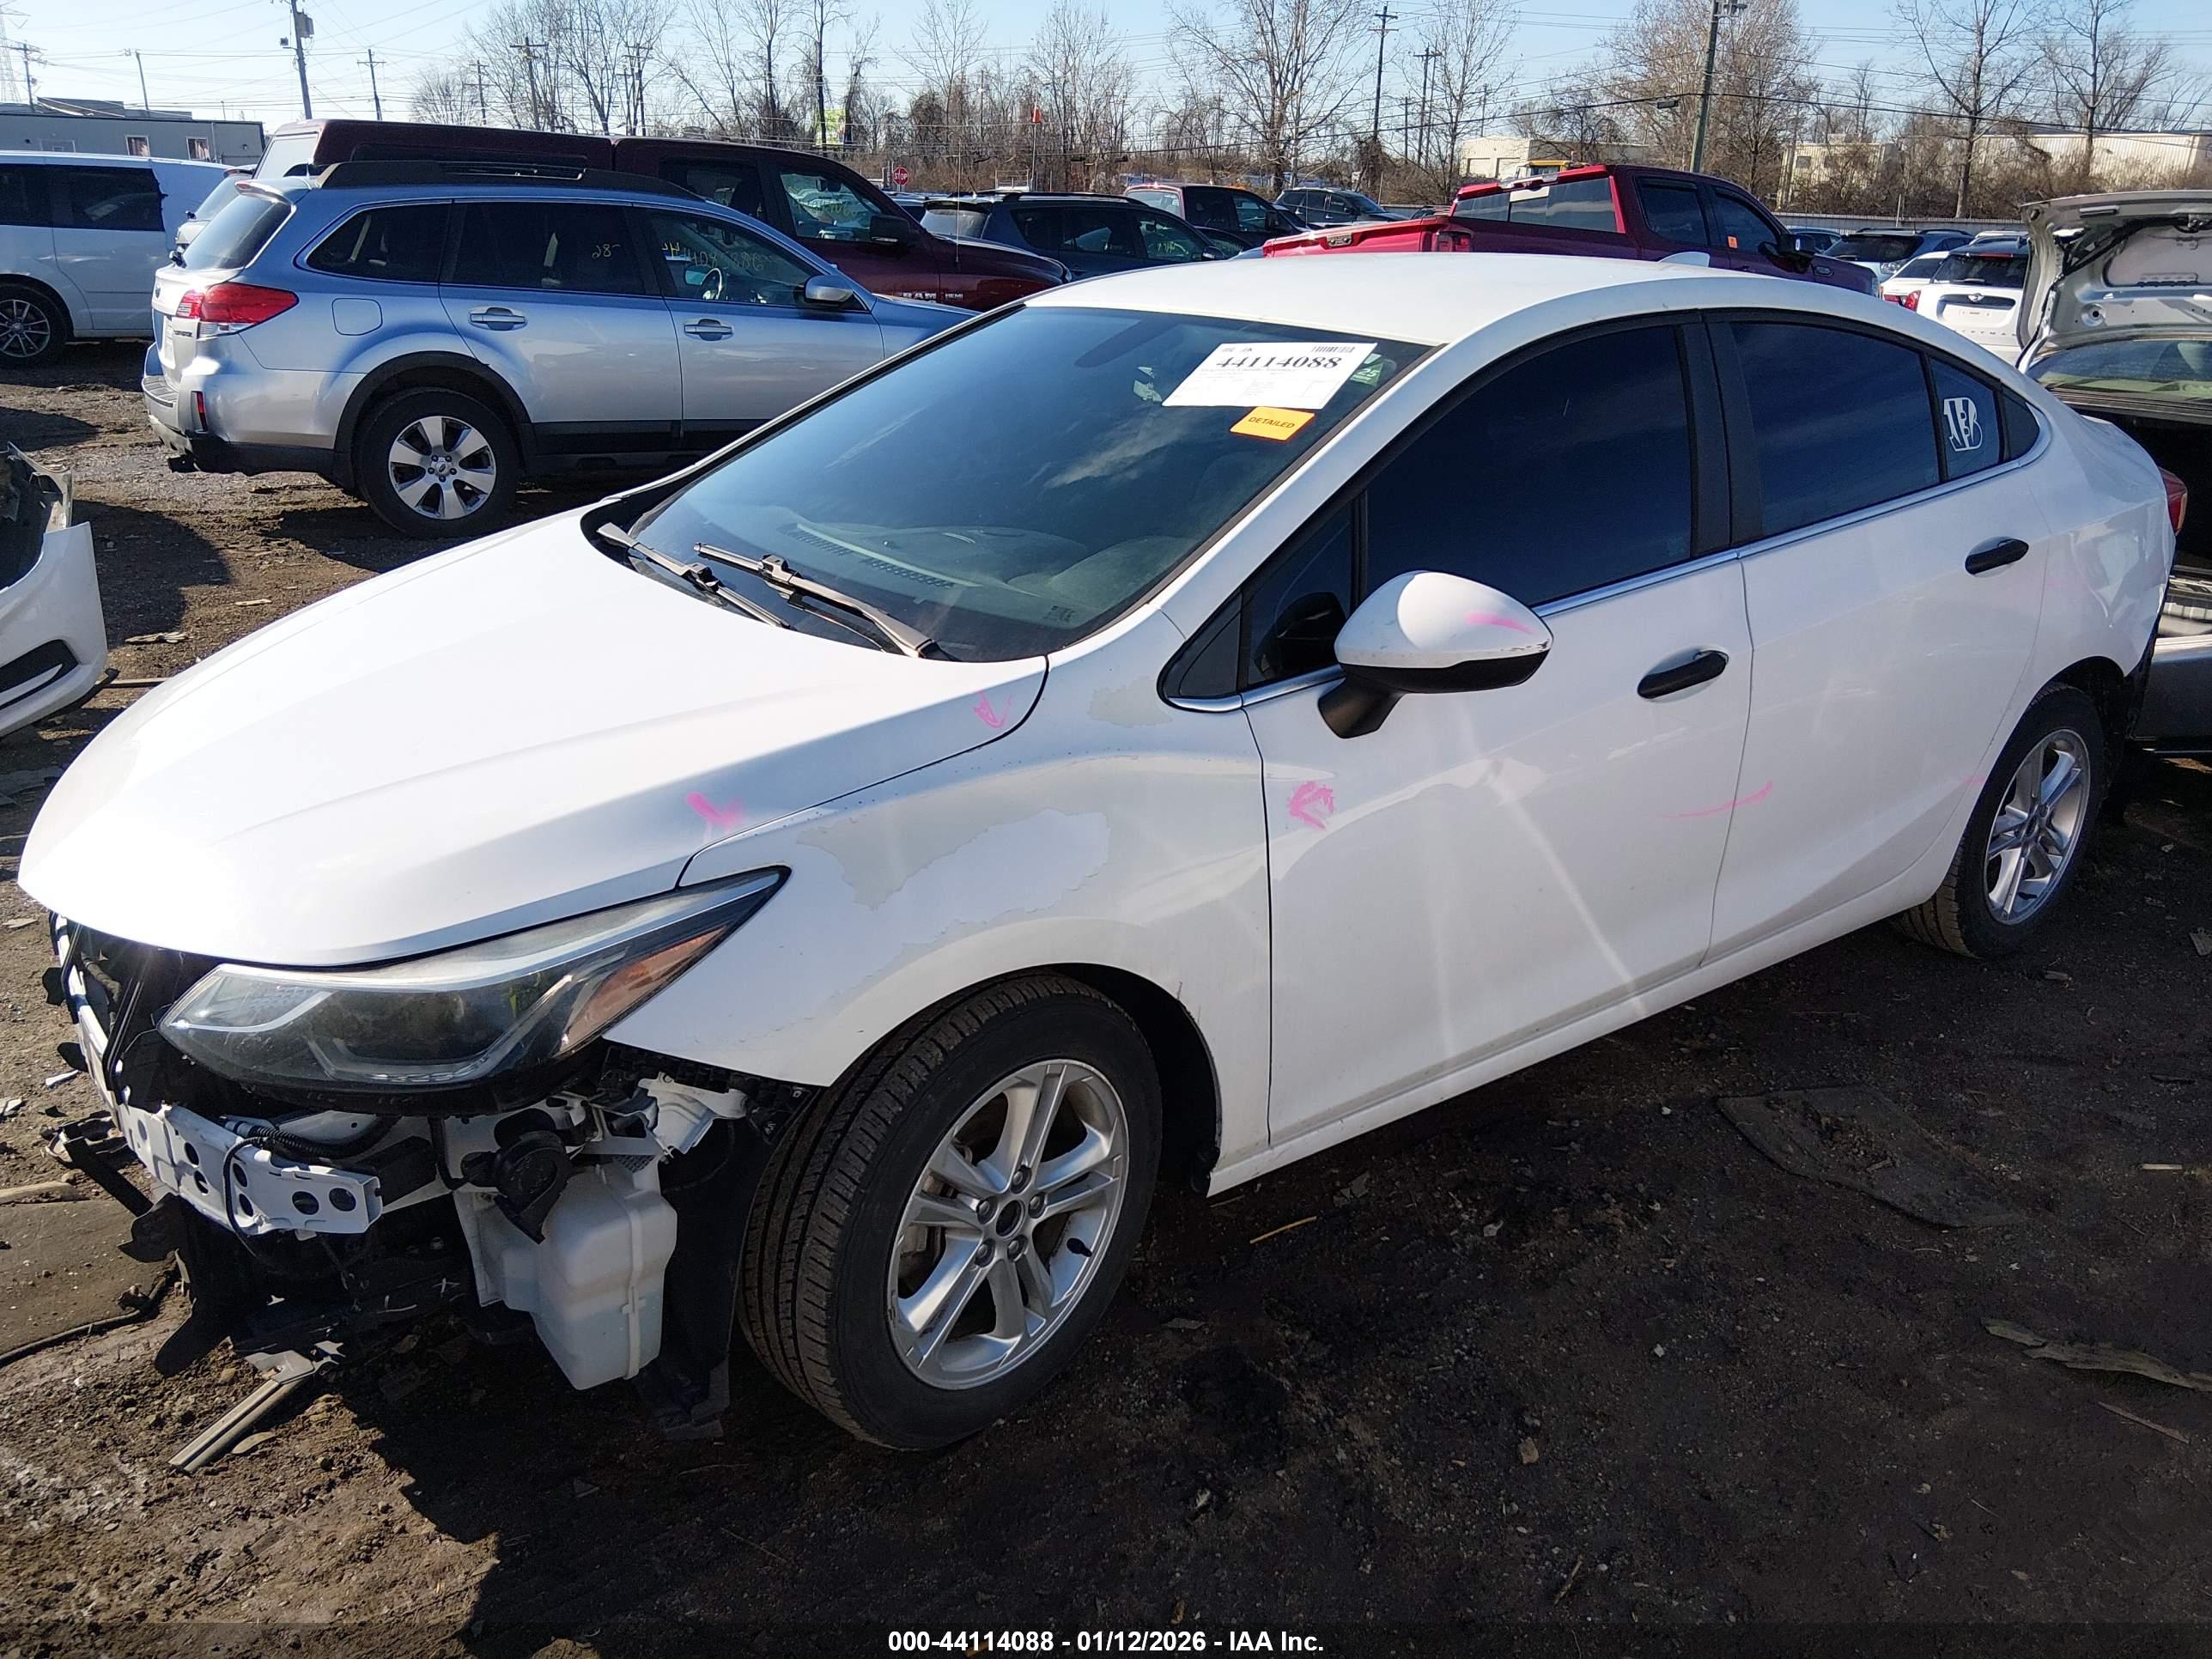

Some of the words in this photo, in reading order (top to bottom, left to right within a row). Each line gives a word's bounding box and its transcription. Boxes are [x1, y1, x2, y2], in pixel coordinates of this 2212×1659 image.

[902, 292, 937, 301] RAM
[945, 292, 963, 301] HEMI
[1216, 356, 1342, 369] 44114088
[1248, 416, 1296, 428] DETAILED
